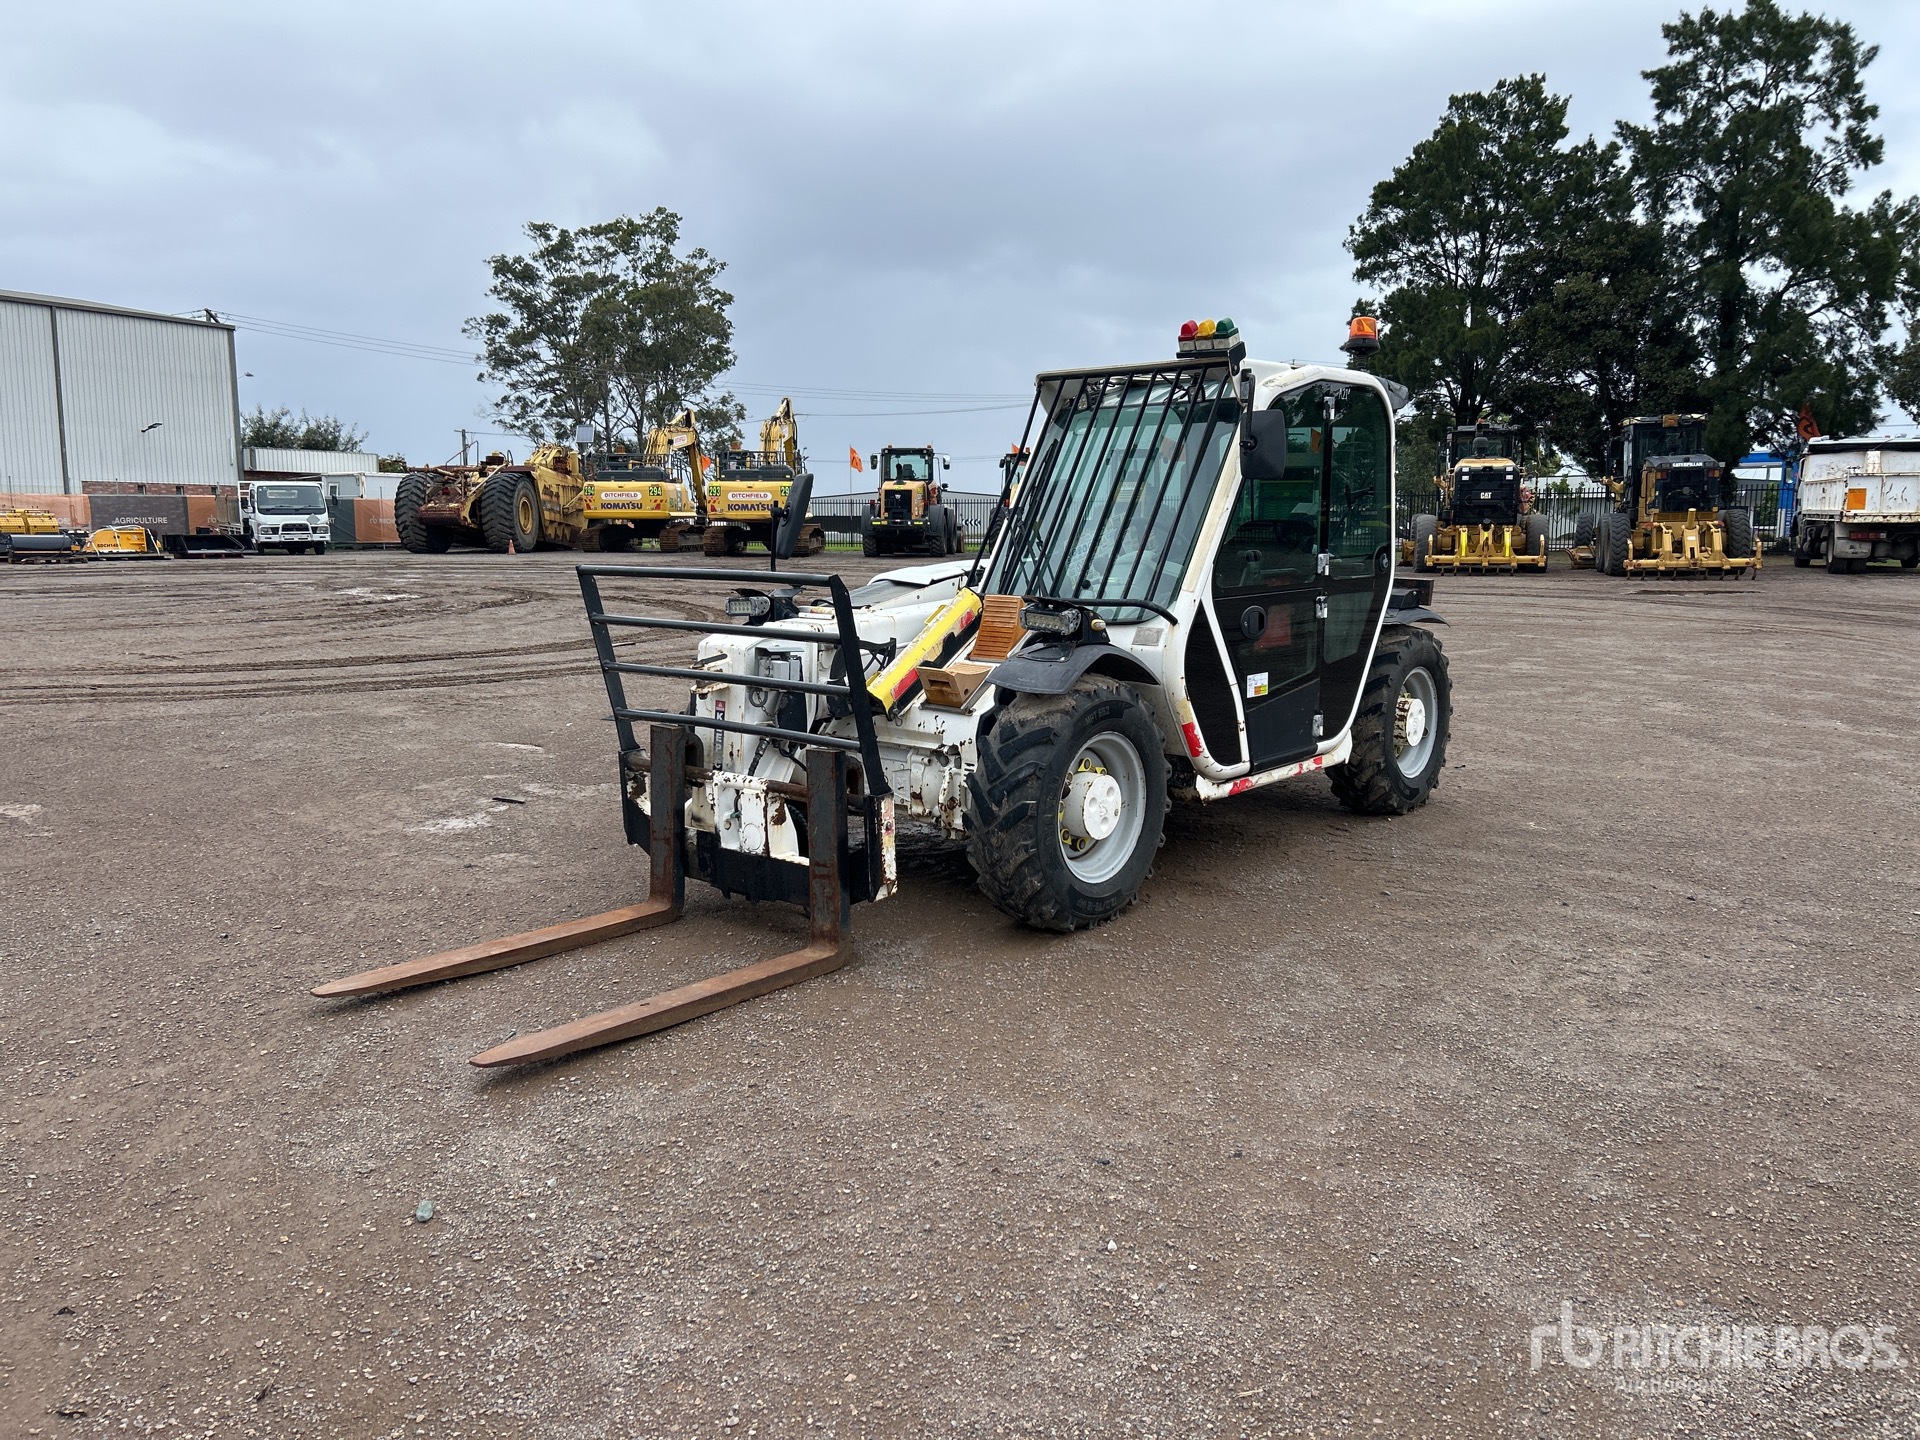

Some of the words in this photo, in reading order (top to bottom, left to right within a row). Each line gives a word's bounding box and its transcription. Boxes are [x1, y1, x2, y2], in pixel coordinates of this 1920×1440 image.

[584, 486, 595, 496] 294
[649, 486, 661, 496] 294
[709, 486, 720, 496] 293
[727, 503, 774, 511] KOMATSU
